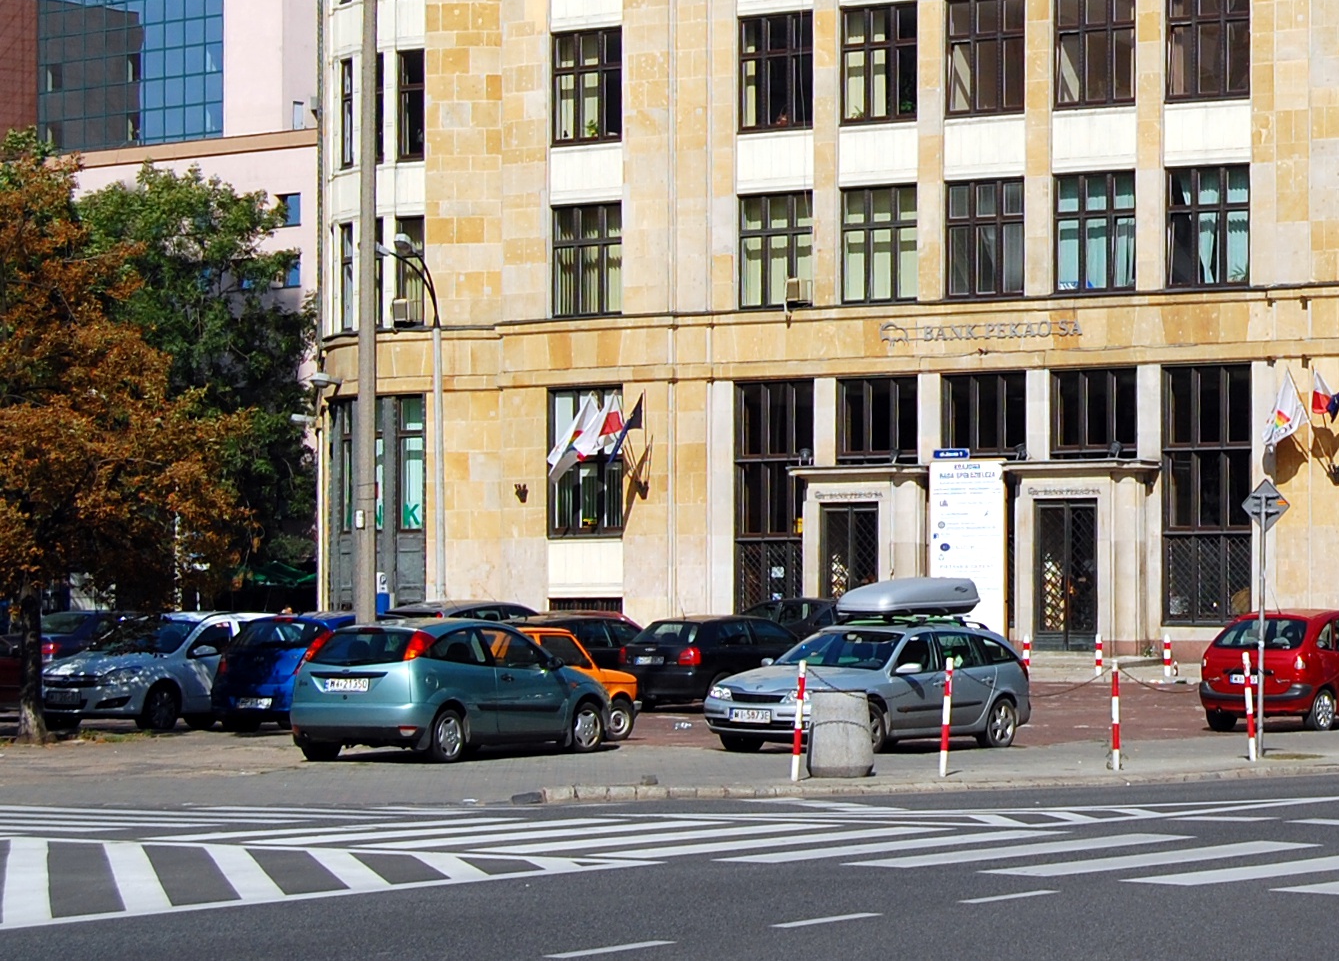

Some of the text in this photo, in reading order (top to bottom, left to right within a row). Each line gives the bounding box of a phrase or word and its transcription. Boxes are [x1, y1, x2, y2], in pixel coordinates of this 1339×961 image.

[923, 318, 1084, 342] BANK PEKAO SA
